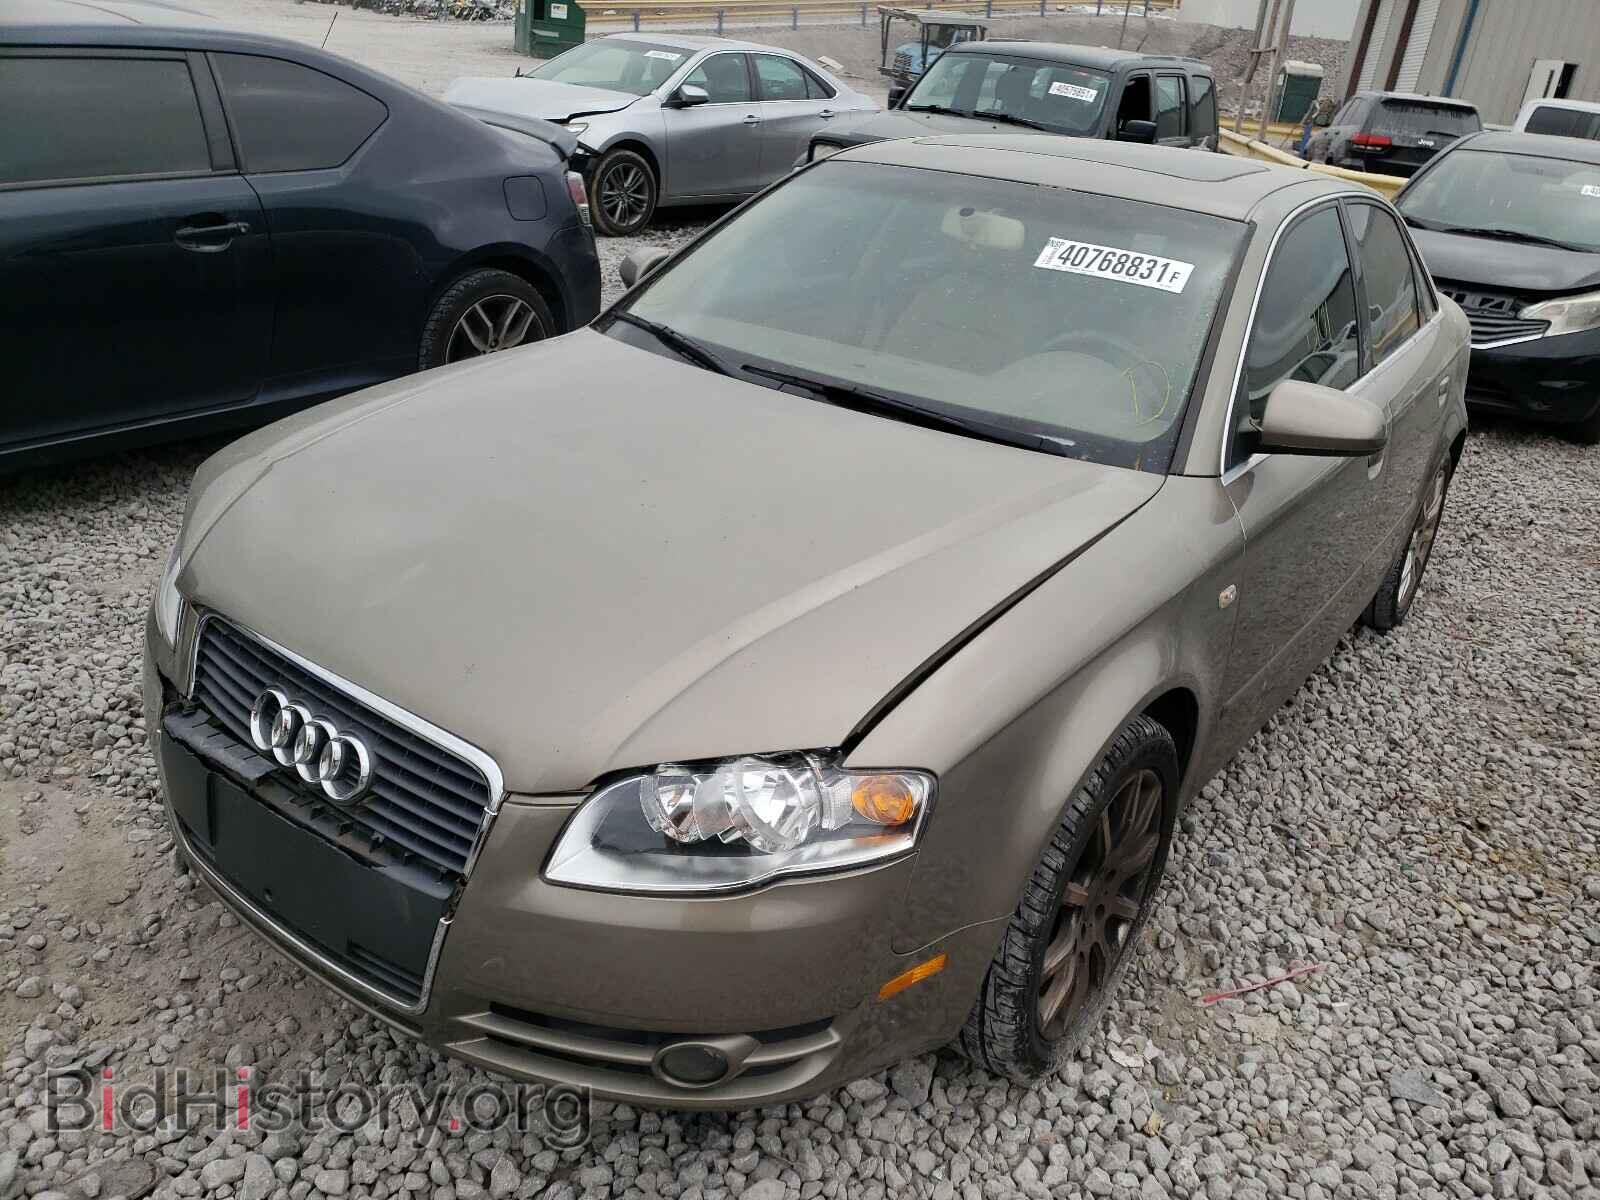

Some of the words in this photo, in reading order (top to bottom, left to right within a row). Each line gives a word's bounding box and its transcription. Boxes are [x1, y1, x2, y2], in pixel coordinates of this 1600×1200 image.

[1418, 138, 1434, 148] Jeep
[1058, 245, 1171, 283] 40768831
[1170, 271, 1181, 283] F
